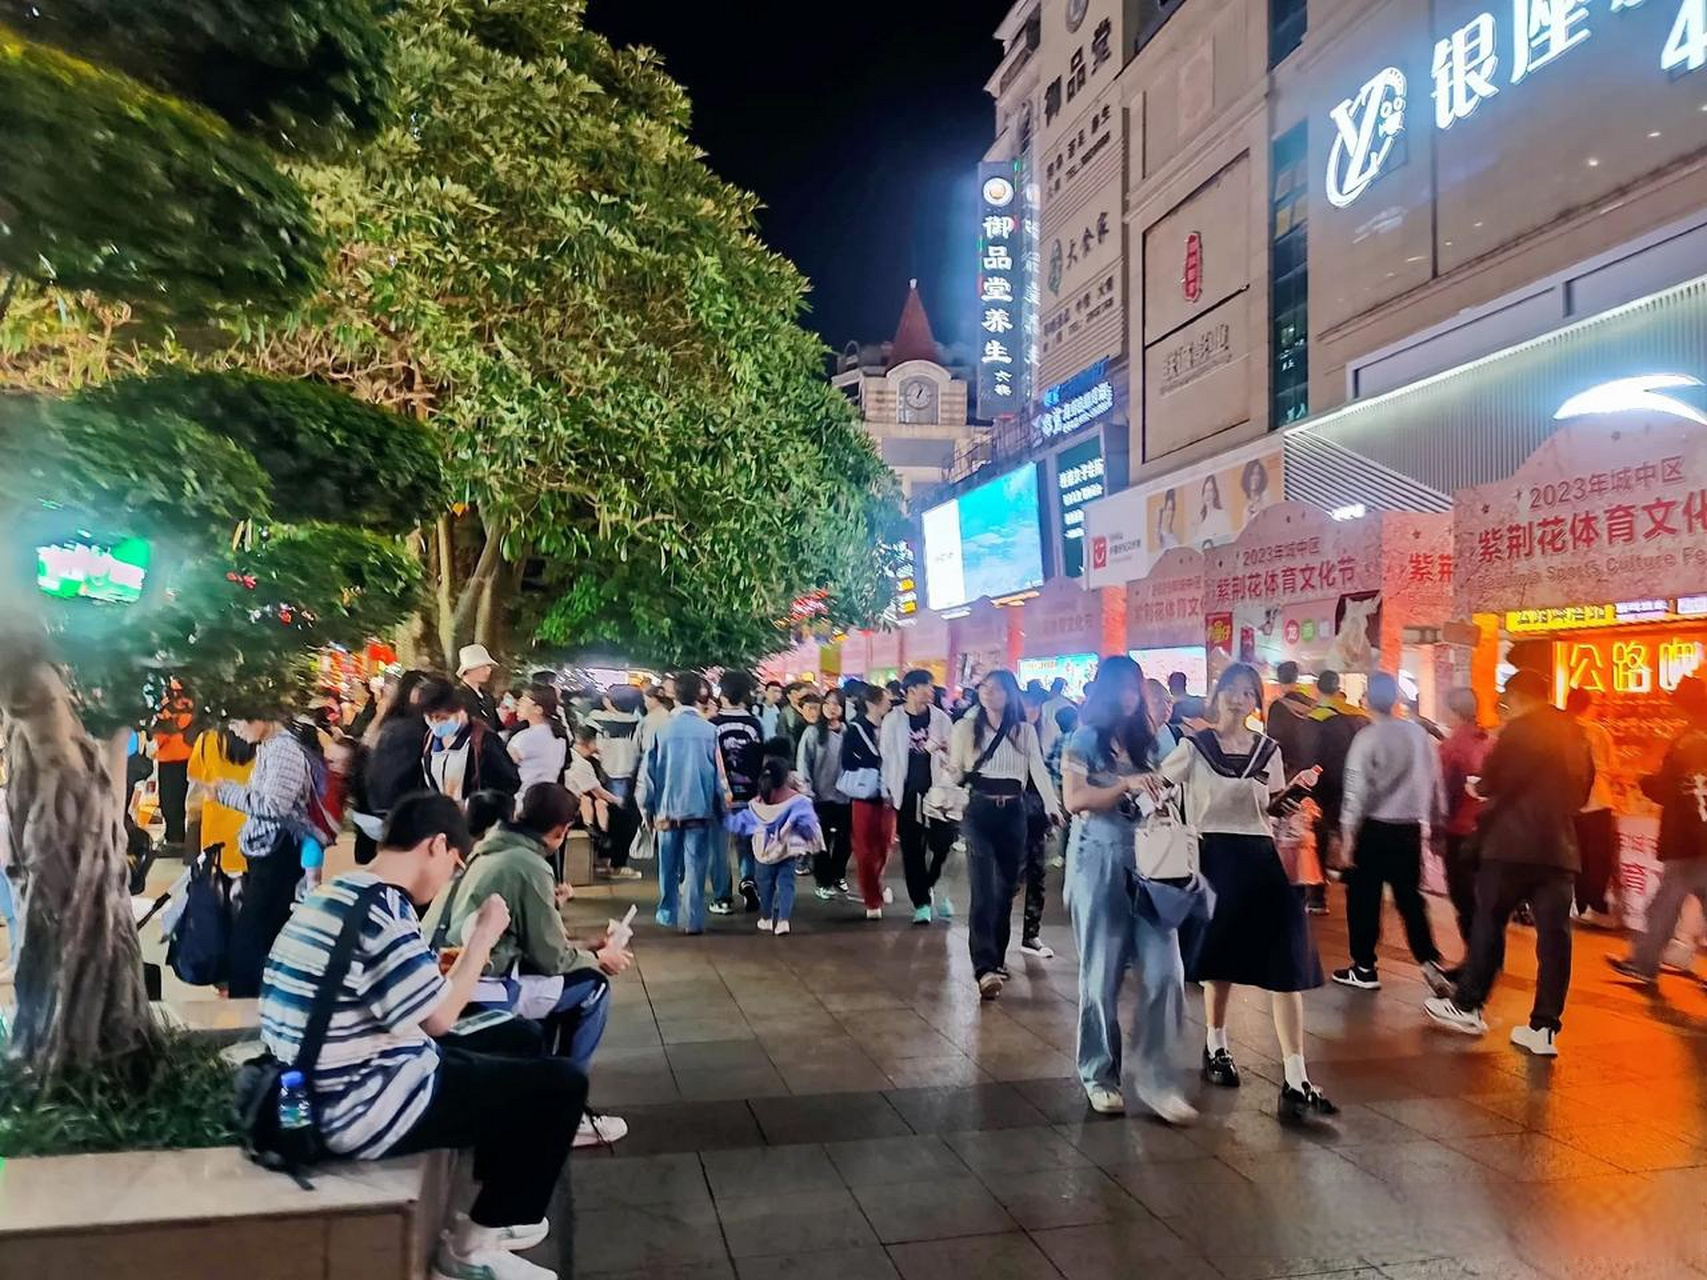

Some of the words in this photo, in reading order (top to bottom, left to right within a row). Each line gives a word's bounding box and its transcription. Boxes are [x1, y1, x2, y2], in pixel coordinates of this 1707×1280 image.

[1430, 0, 1647, 131] 银座
[981, 215, 1014, 365] 御品堂养生
[1529, 456, 1686, 511] 2023年城中区
[1242, 536, 1322, 567] 2023年城中区
[1605, 549, 1677, 576] Culture
[1216, 555, 1357, 602] 紫荆花体育文化节
